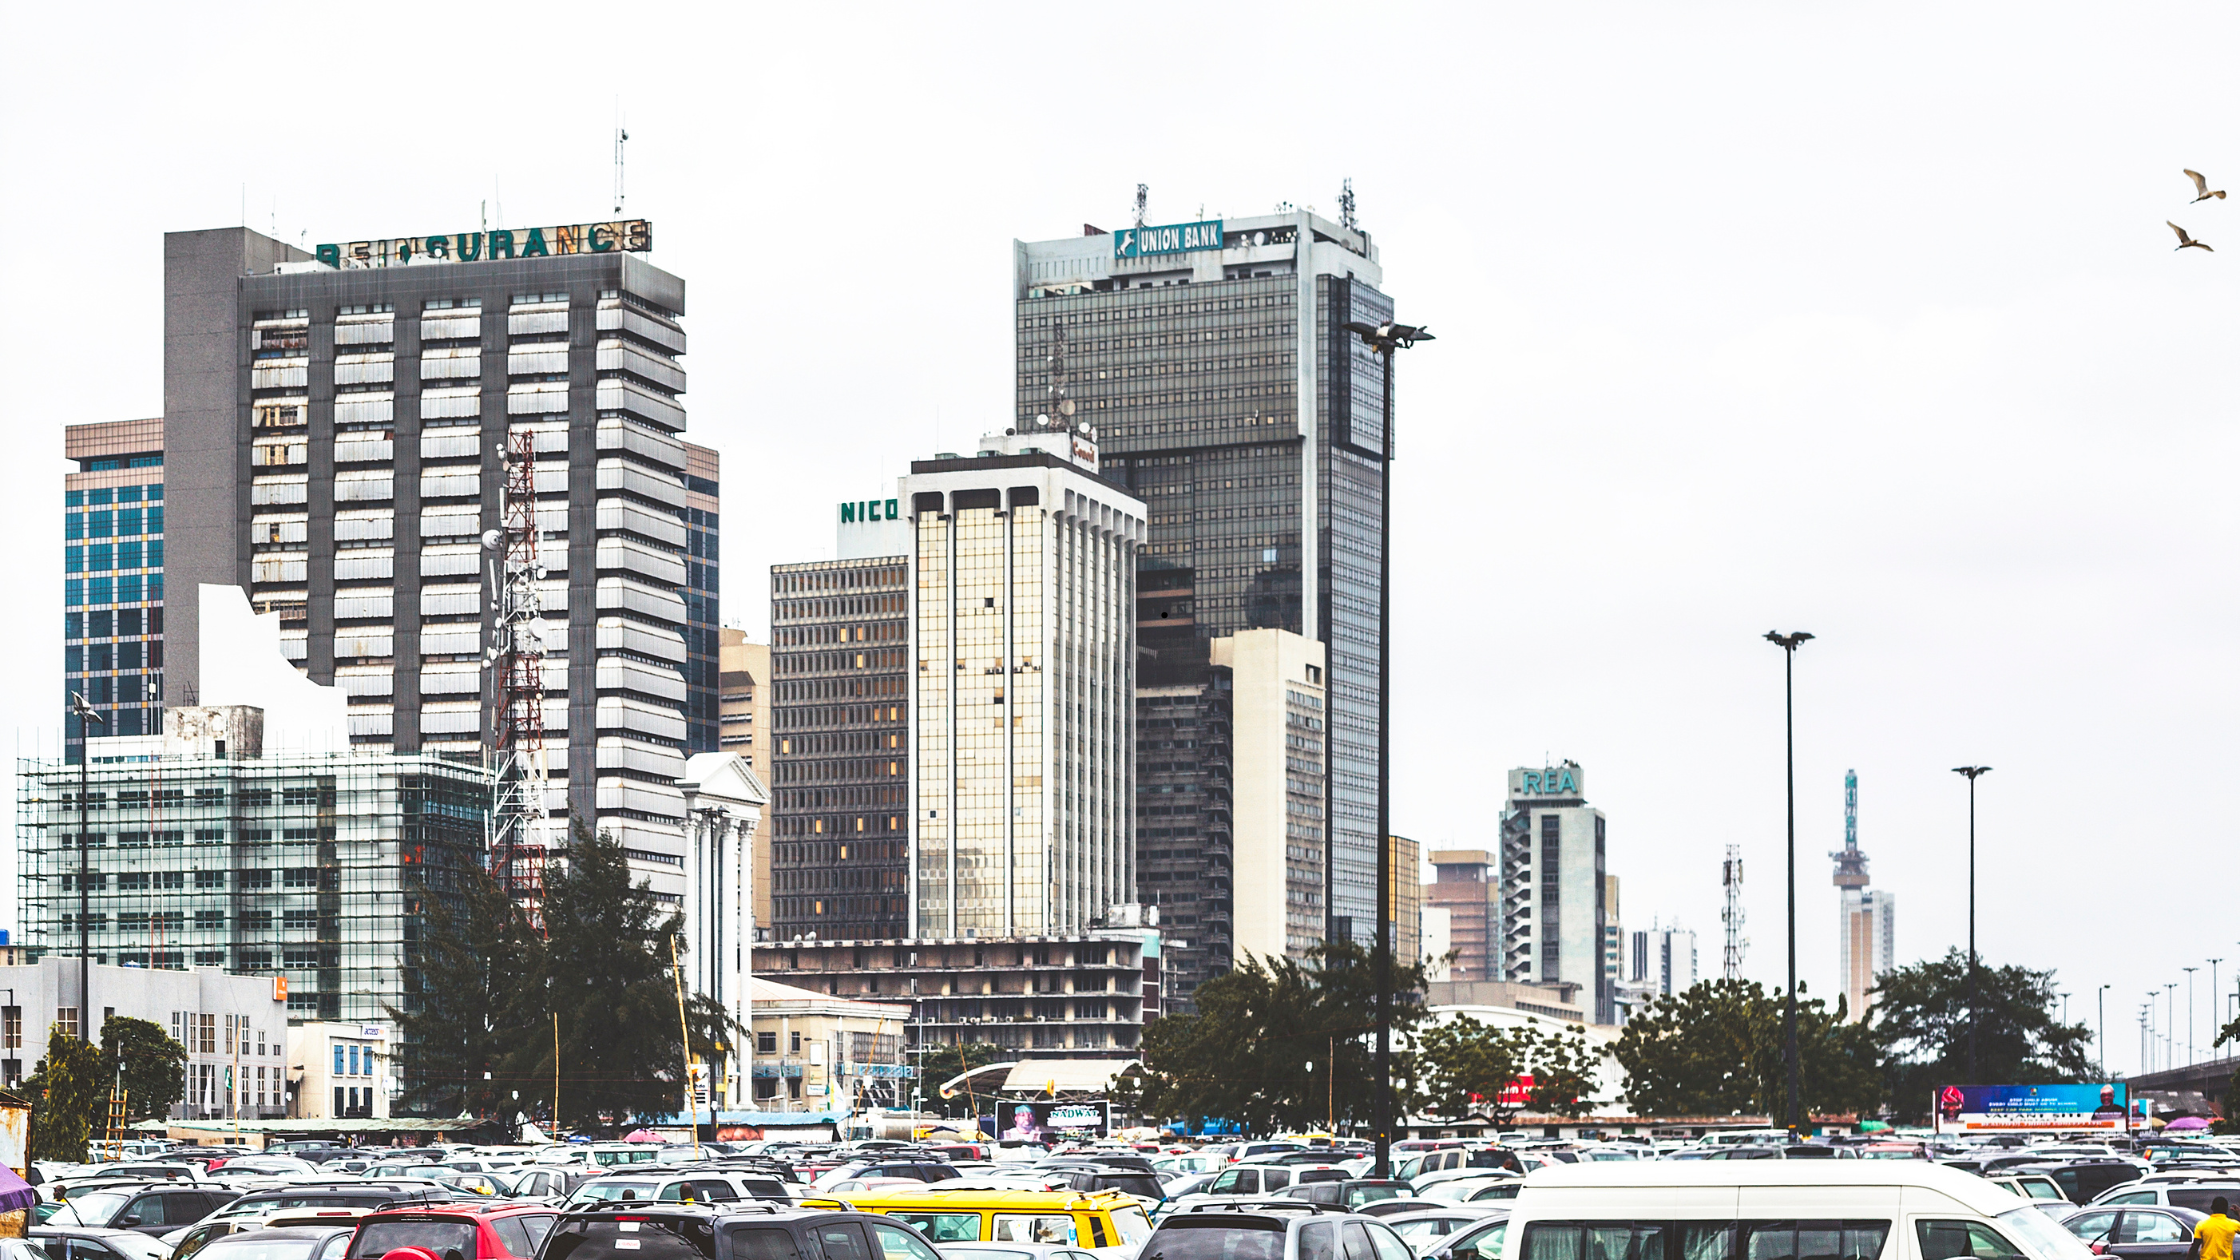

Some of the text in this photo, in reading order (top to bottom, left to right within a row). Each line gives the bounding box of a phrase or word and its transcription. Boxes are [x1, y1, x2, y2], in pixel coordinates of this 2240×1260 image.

[316, 220, 650, 270] REINSURANCE
[1141, 224, 1218, 253] UNION BANK
[841, 498, 898, 524] NICO
[1523, 770, 1578, 795] REA
